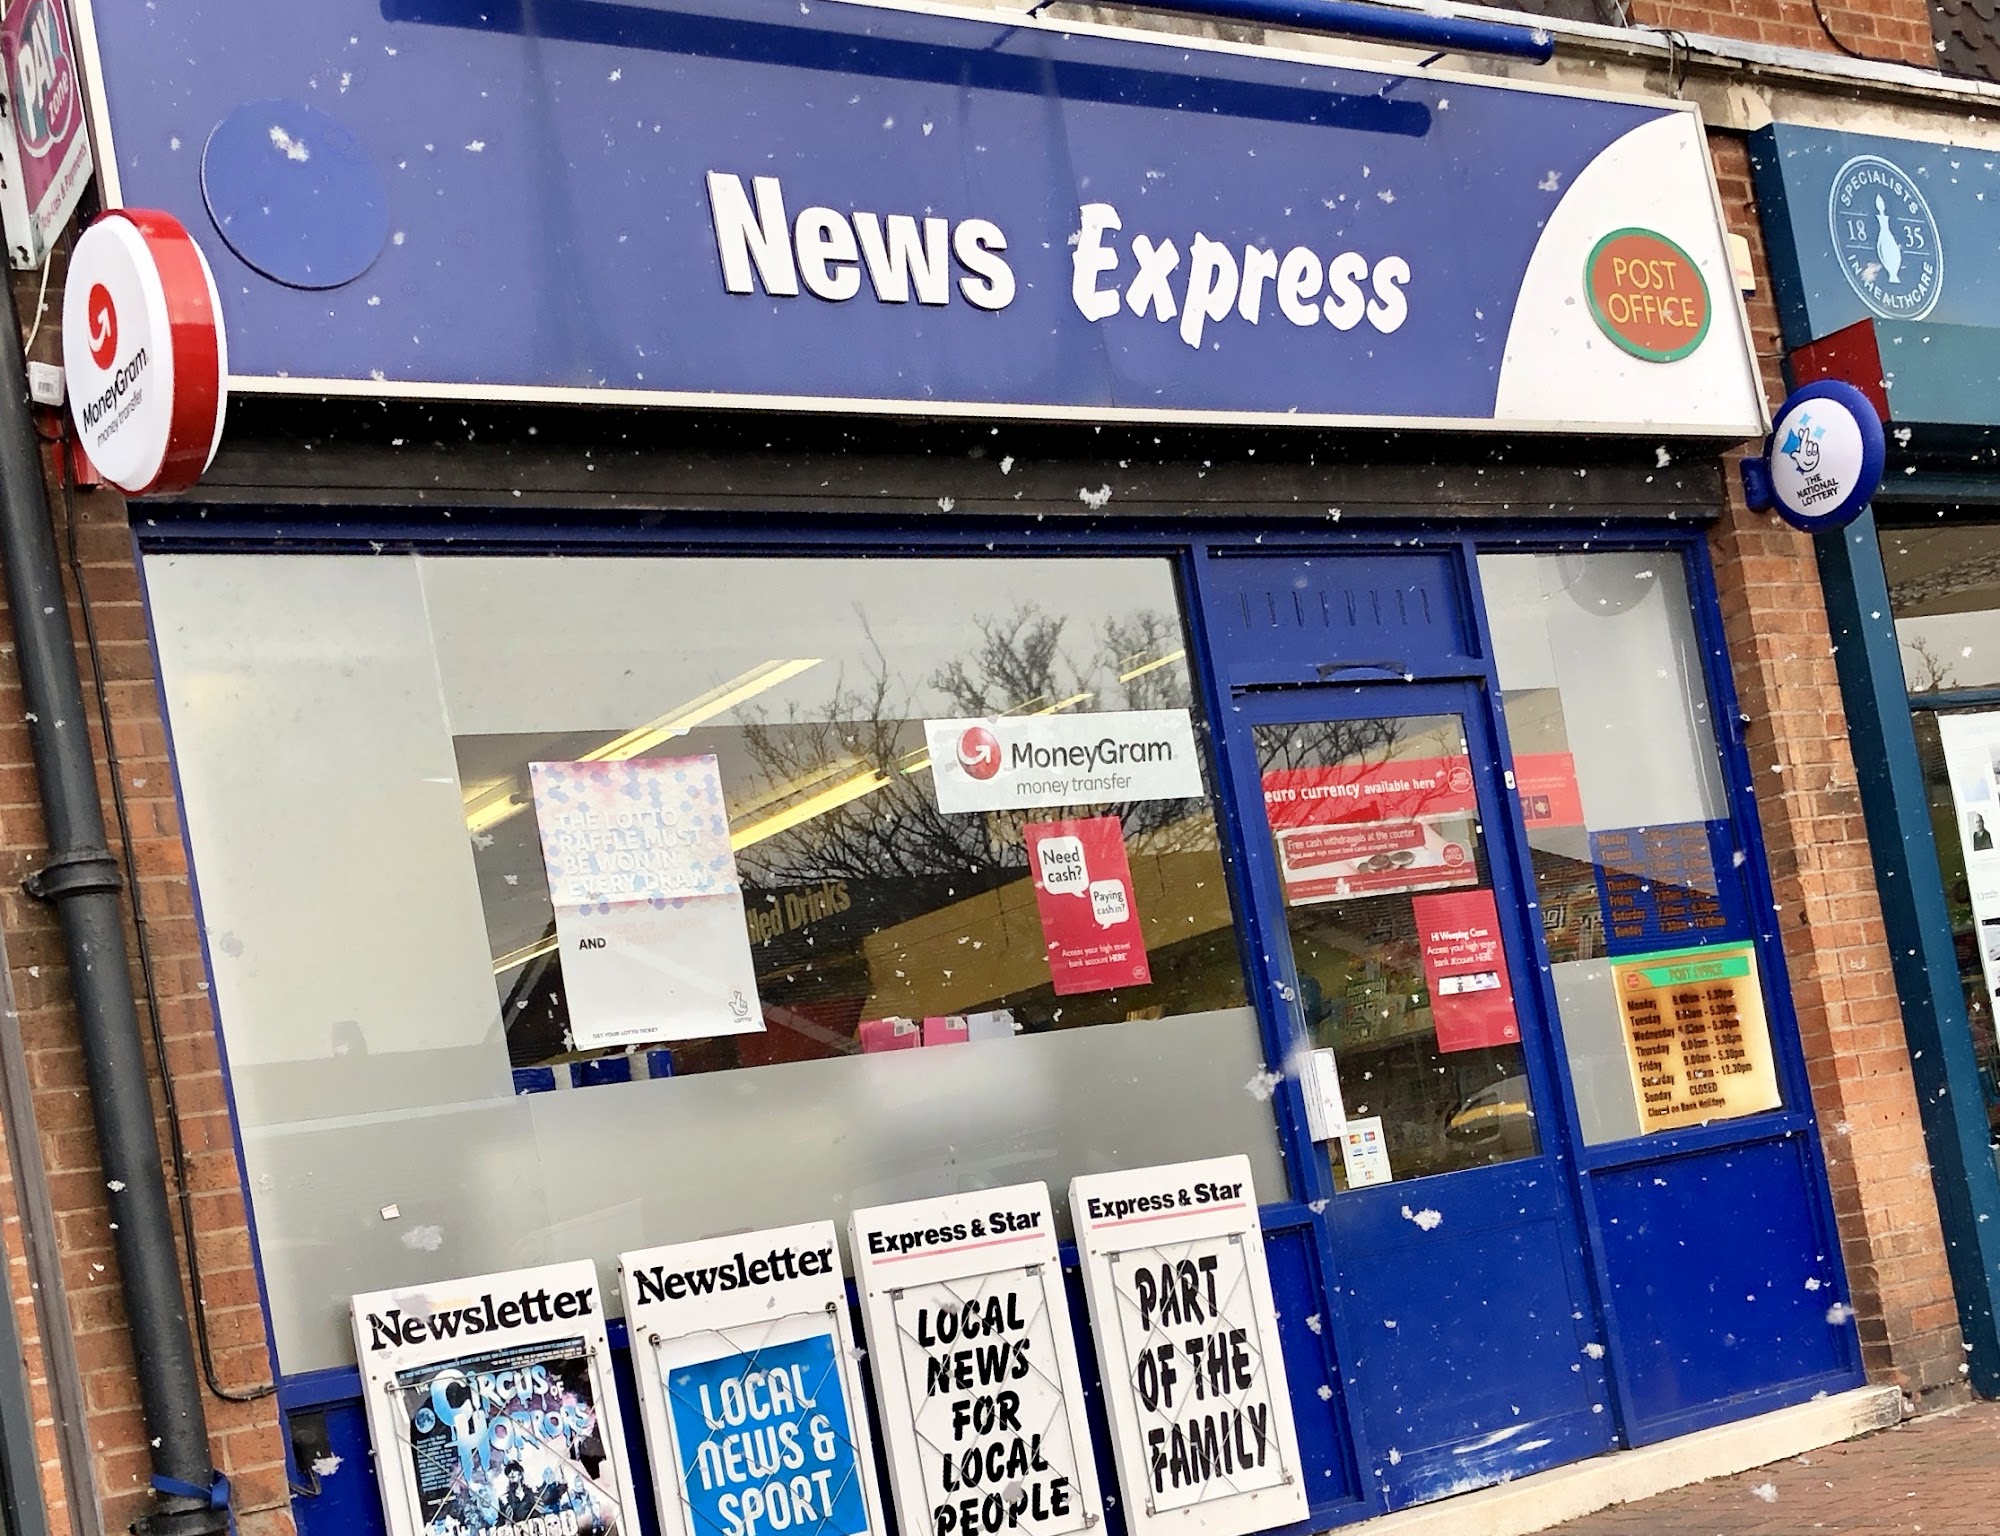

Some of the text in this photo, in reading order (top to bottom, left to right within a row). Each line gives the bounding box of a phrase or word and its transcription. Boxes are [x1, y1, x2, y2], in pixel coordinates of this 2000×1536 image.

[18, 0, 57, 143] PAY
[49, 70, 69, 126] zone
[1840, 169, 1919, 215] SPECIALISTS
[1847, 219, 1925, 249] 18 35
[706, 171, 1411, 349] News Express
[1612, 256, 1678, 291] POST
[1847, 254, 1934, 309] IN HEALTHCARE
[1607, 292, 1699, 328] OFFICE
[82, 347, 147, 435] MoneyGram
[97, 388, 143, 448] money transfer
[1796, 478, 1839, 499] NATIONAL
[1804, 473, 1822, 486] THE
[1801, 487, 1838, 507] LOTTERY
[1011, 737, 1172, 773] MoneyGram
[1016, 773, 1132, 796] money transfer
[1264, 778, 1436, 803] euro currency available here
[557, 807, 679, 834] THE LOTTO
[558, 826, 704, 853] RAFFLE MUST
[1043, 846, 1080, 865] Need
[1287, 839, 1305, 851] Free
[1305, 837, 1322, 849] cash
[1389, 829, 1415, 840] counter
[562, 848, 677, 876] BE WON IN
[1048, 865, 1082, 883] cash?
[566, 868, 710, 897] EVERY DRAW
[1093, 889, 1124, 905] Paying
[784, 879, 852, 930] Drinks
[1097, 902, 1126, 915] cash in?
[579, 938, 607, 951] AND
[1614, 925, 1643, 938] Sunday
[1450, 944, 1464, 955] your
[1627, 998, 1657, 1012] Monday
[1630, 1014, 1662, 1027] Tuesday
[592, 1032, 604, 1040] GET
[1632, 1028, 1675, 1042] Wednesday
[1635, 1044, 1670, 1057] Thursday
[1638, 1061, 1662, 1073] Friday
[1683, 1054, 1712, 1066] 9.00am
[1641, 1074, 1675, 1088] Saturday
[1721, 1062, 1752, 1076] 12.30pm
[1644, 1082, 1718, 1103] Sunday CLOSED
[1680, 1101, 1698, 1112] Bank
[1087, 1182, 1243, 1220] Express & Star
[867, 1211, 1042, 1255] Express & Star
[633, 1245, 834, 1306] Newsletter
[1134, 1255, 1218, 1332] PART
[366, 1286, 594, 1352] Newsletter
[917, 1291, 1026, 1348] LOCAL
[926, 1339, 1032, 1398] NEWS
[1137, 1328, 1252, 1413] OF THE
[415, 1383, 431, 1396] THE
[430, 1364, 565, 1428] CIRCUS OF
[699, 1363, 817, 1430] LOCAL
[951, 1390, 1023, 1442] FOR
[450, 1403, 594, 1482] HORRORS
[697, 1413, 837, 1491] NEWS &
[1147, 1402, 1268, 1494] FAMILY
[942, 1433, 1049, 1493] LOCAL
[717, 1469, 833, 1536] SPORT
[934, 1476, 1070, 1536] PEOPLE
